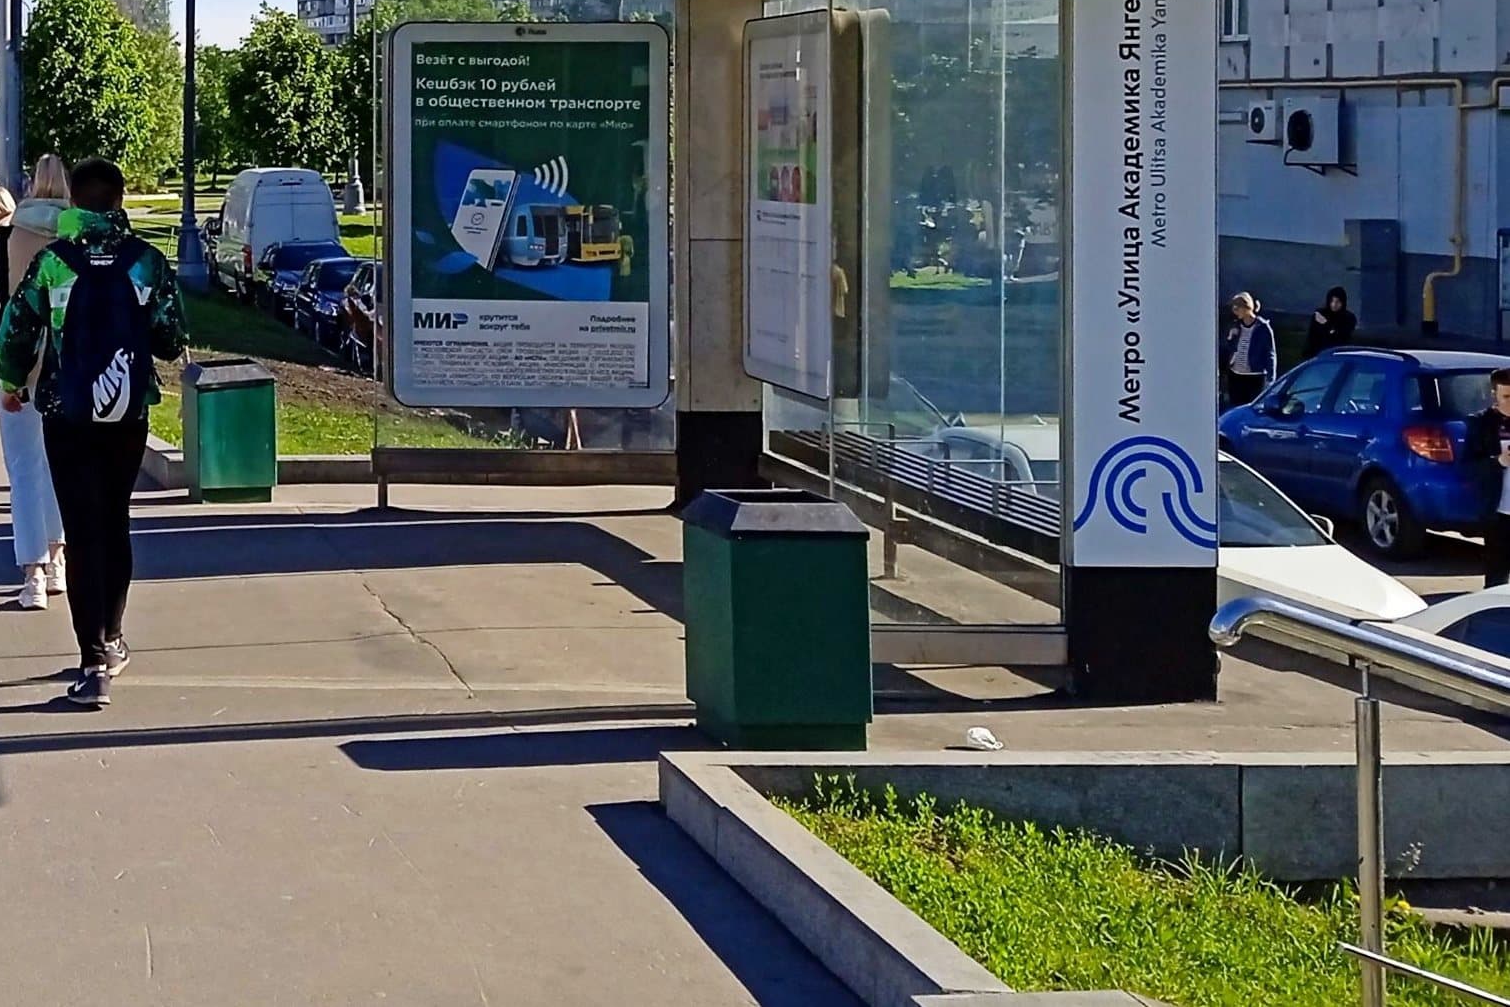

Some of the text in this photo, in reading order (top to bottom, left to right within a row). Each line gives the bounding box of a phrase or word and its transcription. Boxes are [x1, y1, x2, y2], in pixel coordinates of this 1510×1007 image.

[415, 76, 557, 94] Кешбэк 10 рублей
[416, 53, 530, 68] Везёт с выгодой!
[1150, 33, 1167, 132] Akademika
[415, 95, 642, 112] в общественном транспорте
[415, 117, 436, 128] при
[437, 118, 475, 127] оплате
[478, 118, 548, 130] смартфоном
[549, 120, 564, 129] по
[566, 121, 597, 131] карте
[1118, 68, 1144, 220] Академика
[1150, 138, 1166, 187] Ulitsa
[1151, 192, 1166, 248] Metro
[1118, 226, 1144, 323] «Улица
[413, 312, 469, 330] МИР
[1118, 331, 1145, 423] Метро
